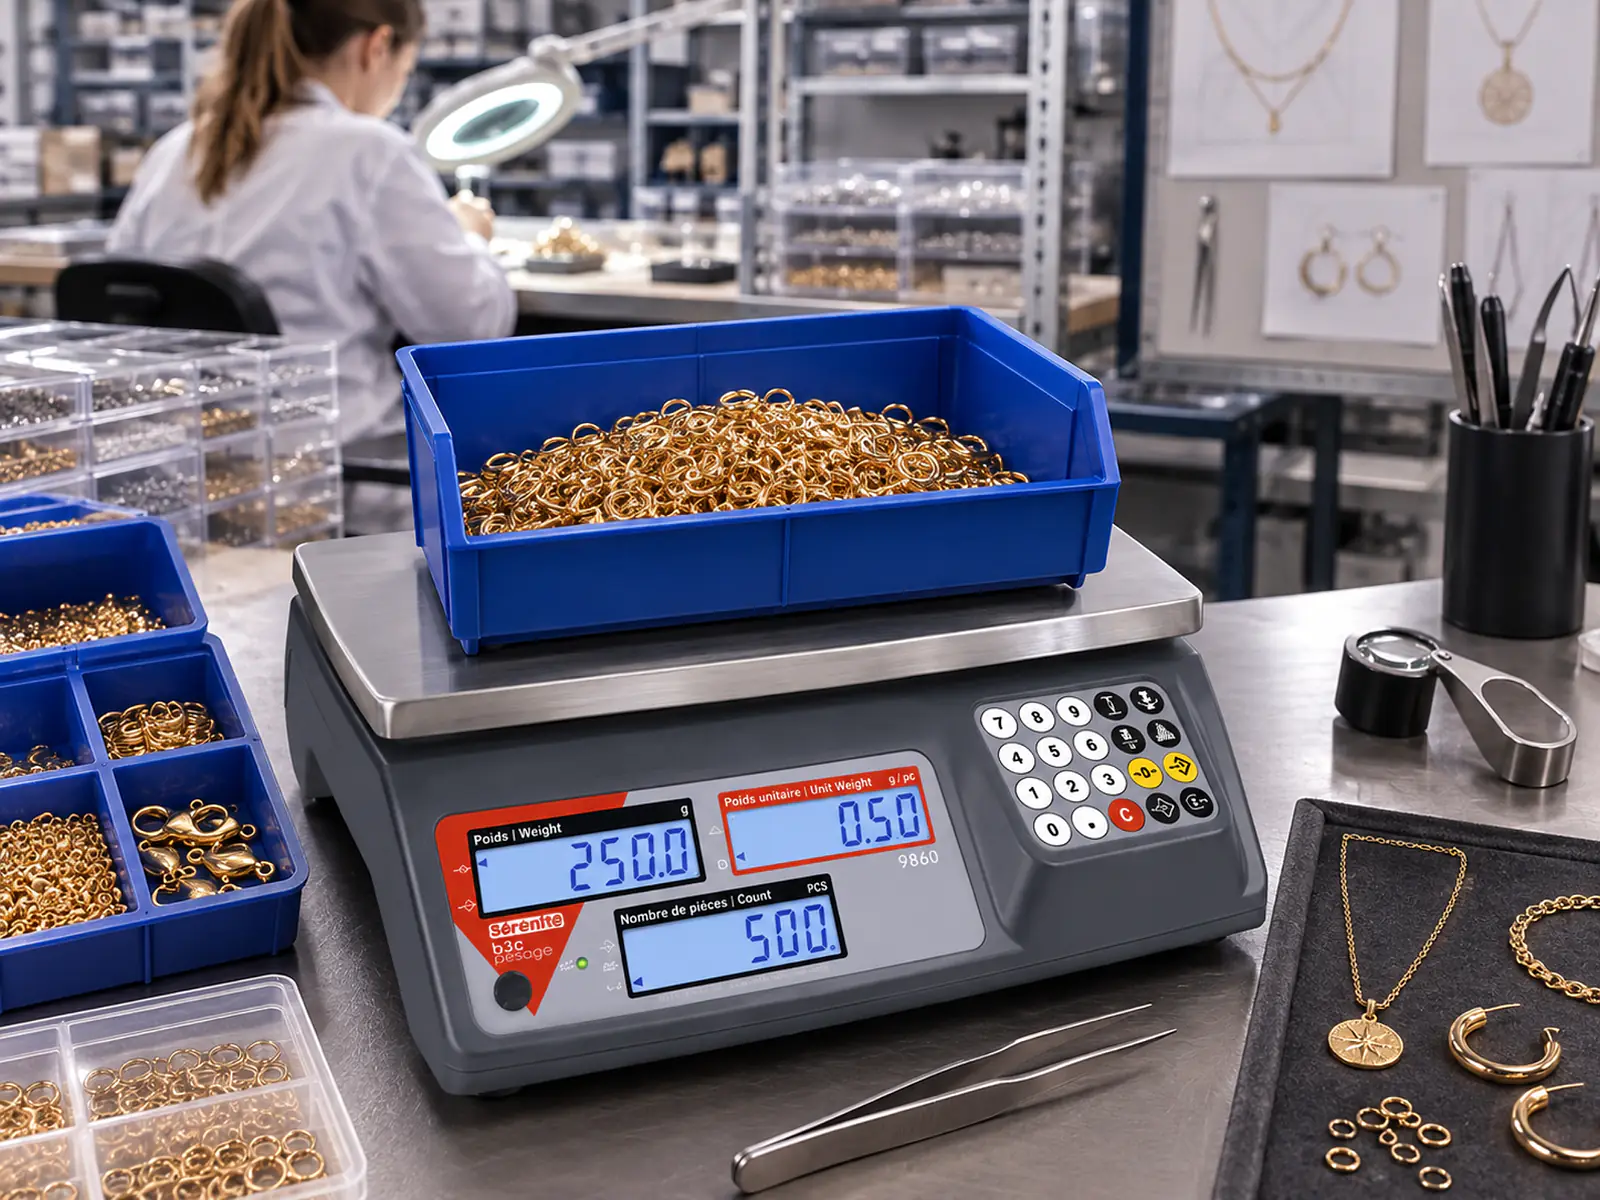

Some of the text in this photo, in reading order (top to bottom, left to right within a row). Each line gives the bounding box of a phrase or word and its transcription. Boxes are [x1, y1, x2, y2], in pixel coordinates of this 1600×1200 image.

[993, 705, 1080, 730] 7 8 9
[1012, 739, 1097, 764] 4 5 6
[903, 773, 916, 784] pc
[1029, 773, 1114, 800] 1 2 3
[724, 794, 756, 807] Poids
[759, 788, 801, 802] unitaire
[809, 784, 833, 795] Unit
[834, 778, 873, 791] Weight
[680, 805, 689, 817] g
[838, 792, 920, 847] 0.50
[1119, 808, 1132, 821] C
[473, 831, 509, 846] Poids
[518, 822, 562, 838] Weight
[1048, 823, 1059, 836] 0
[570, 827, 689, 892] 250.0
[898, 850, 939, 869] 9860
[806, 881, 828, 894] PCS
[620, 909, 669, 925] Nombre
[671, 904, 686, 916] de
[737, 890, 772, 904] Count
[492, 940, 524, 955] b3c
[494, 946, 553, 966] pesage
